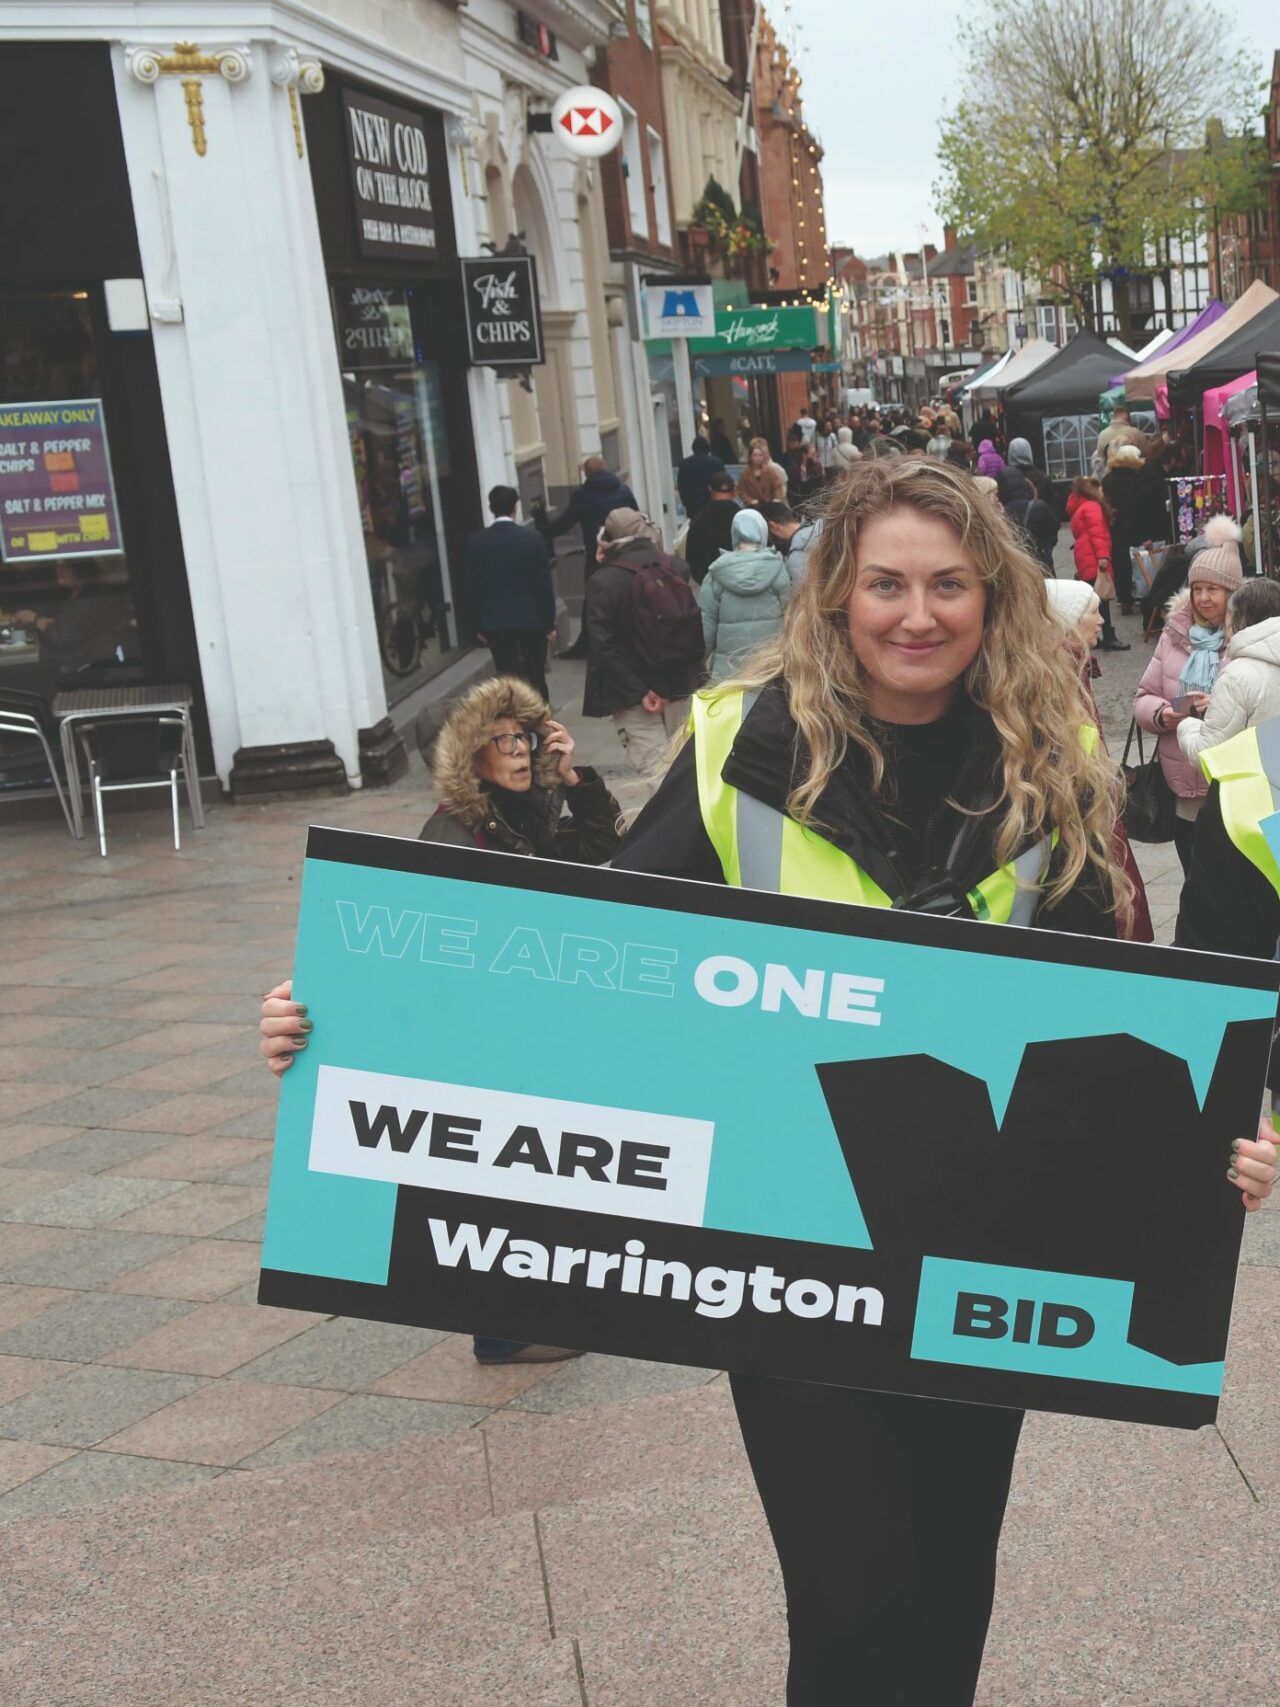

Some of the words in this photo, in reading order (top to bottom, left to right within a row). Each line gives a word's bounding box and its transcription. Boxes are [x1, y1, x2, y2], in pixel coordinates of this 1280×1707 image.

[348, 106, 391, 168] NEW
[394, 122, 429, 176] COD
[356, 166, 376, 201] ON
[374, 171, 399, 206] THE
[398, 177, 432, 212] BLOCK
[473, 270, 519, 309] Fish
[491, 300, 512, 316] &
[476, 320, 531, 344] CHIPS
[0, 410, 60, 427] AKEAWAY
[62, 408, 96, 424] ONLY
[30, 441, 40, 455] &
[43, 438, 91, 454] PEPPER
[0, 458, 35, 474] CHIPS
[5, 499, 31, 515] SALT
[33, 497, 42, 512] &
[44, 495, 84, 511] PEPPER
[85, 493, 106, 509] MIX
[335, 900, 479, 969] WE
[488, 926, 679, 998] ARE
[694, 954, 885, 1026] ONE
[348, 1100, 482, 1164] WE
[492, 1125, 671, 1191] ARE
[428, 1218, 885, 1327] Warrington
[952, 1290, 1096, 1349] BID
